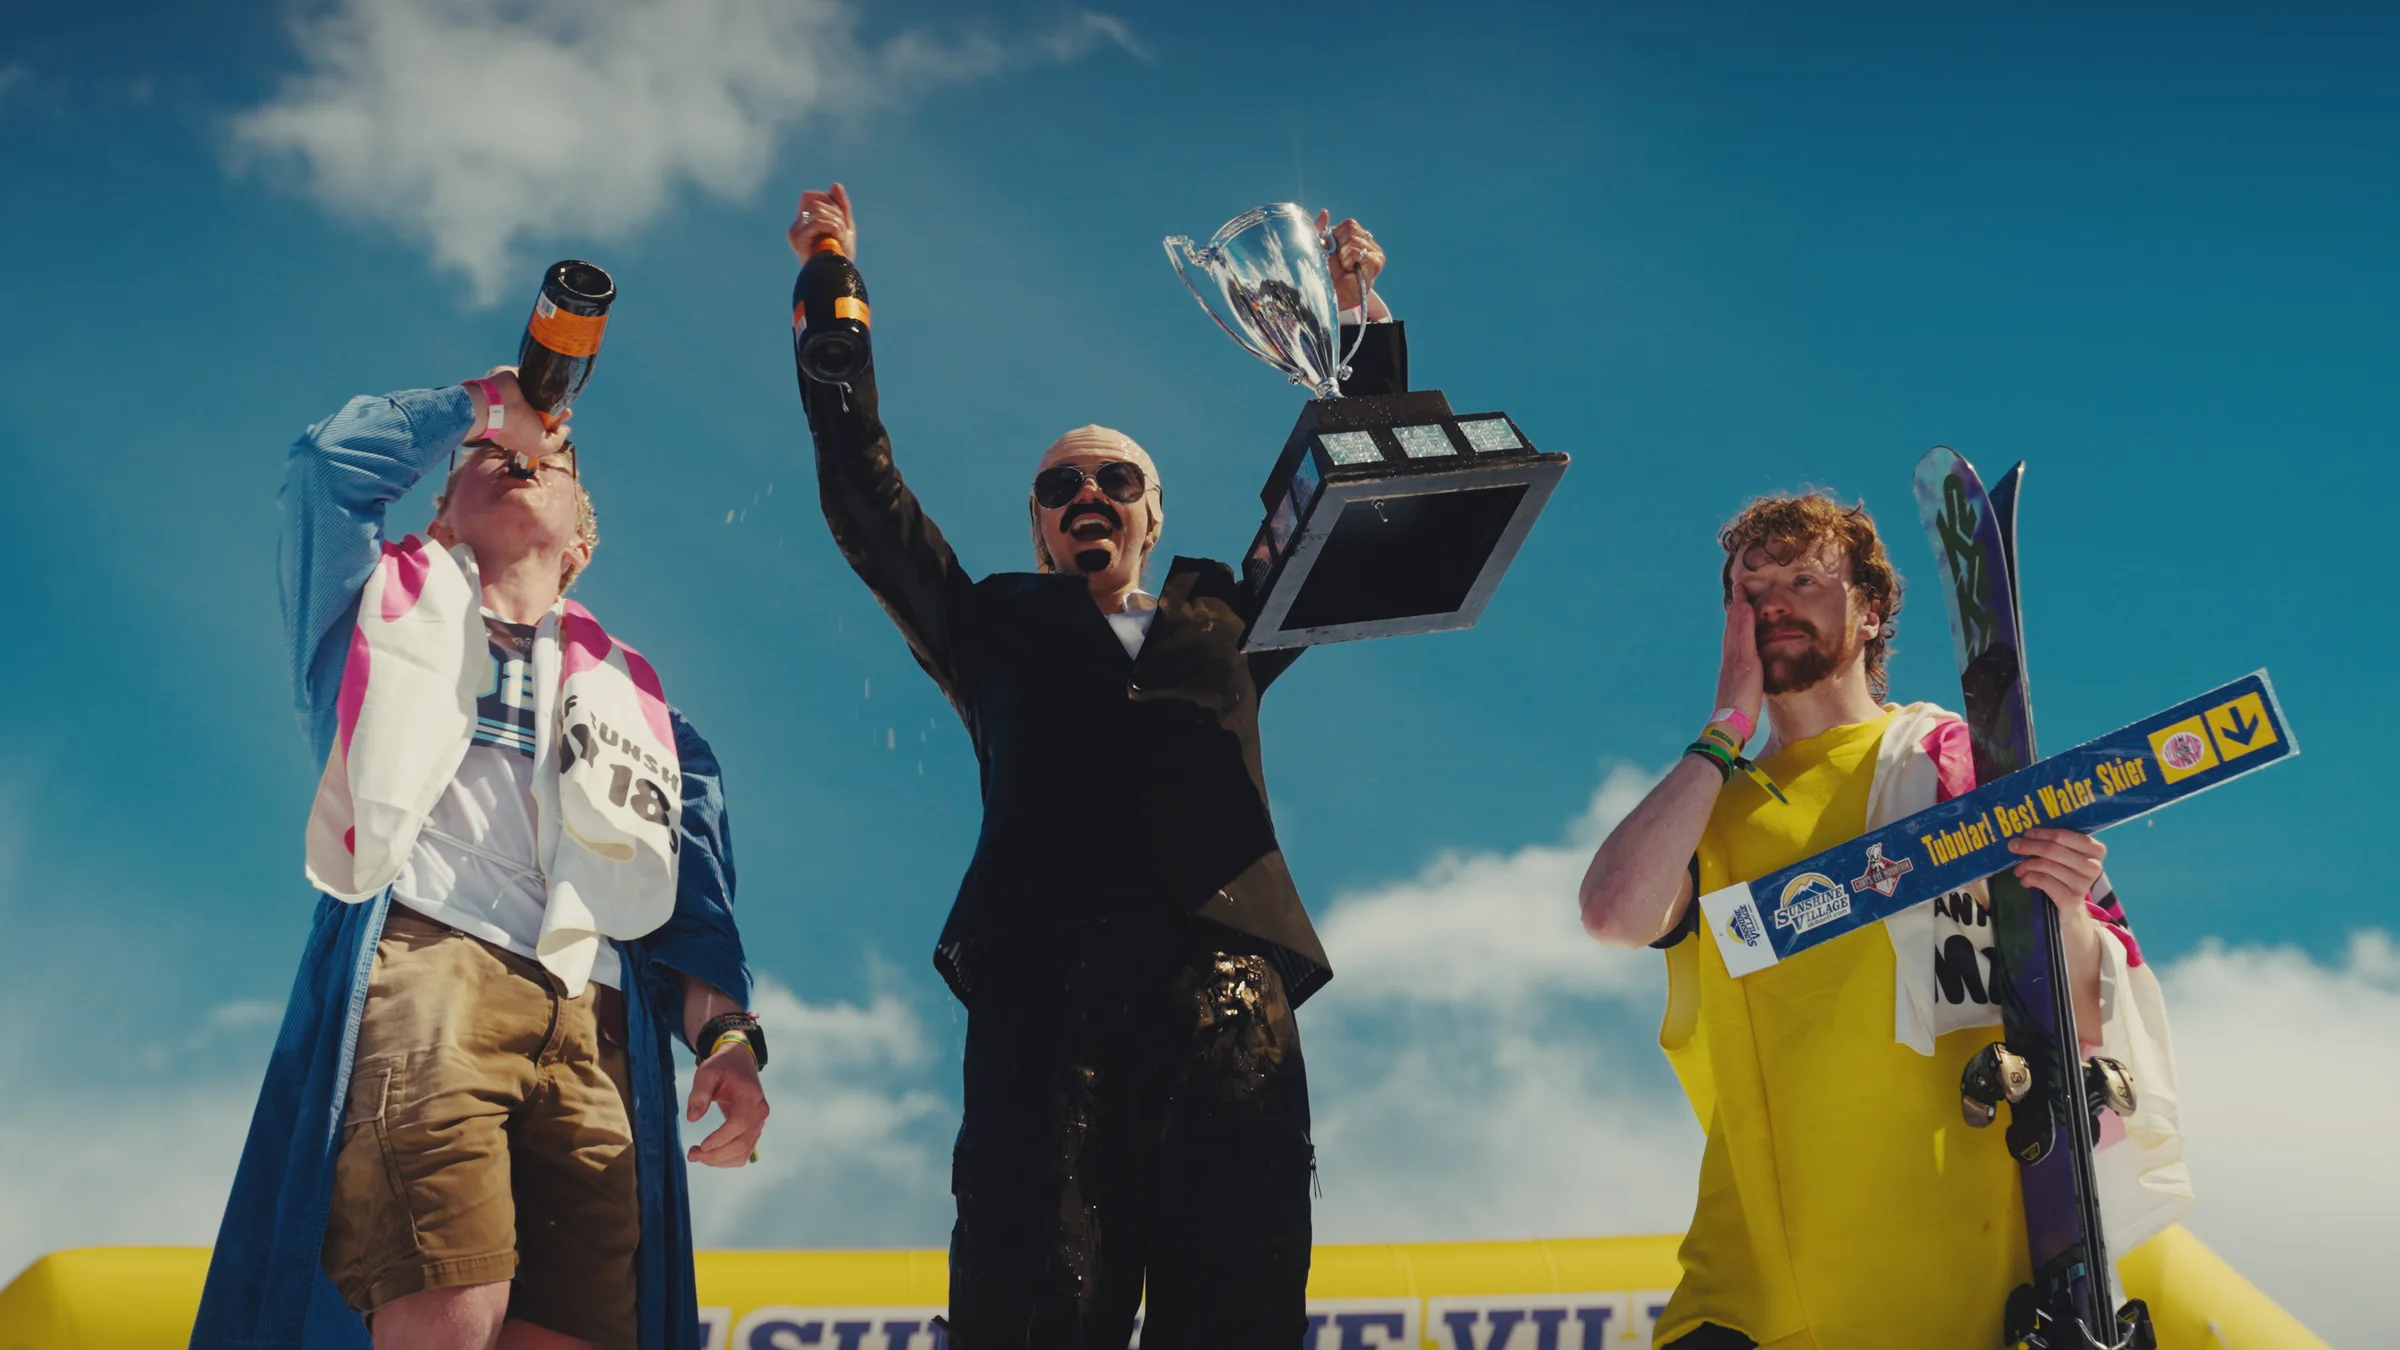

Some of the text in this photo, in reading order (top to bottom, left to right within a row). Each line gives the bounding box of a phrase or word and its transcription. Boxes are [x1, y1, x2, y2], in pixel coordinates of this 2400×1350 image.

[589, 709, 679, 793] UNSH
[1920, 756, 2148, 867] Tubular! Best Water Skier
[1740, 904, 1761, 939] VILLAGE
[1777, 886, 1843, 926] SUNSHINE
[1792, 896, 1848, 930] VILLAGE
[1733, 908, 1758, 947] SUNSHINE
